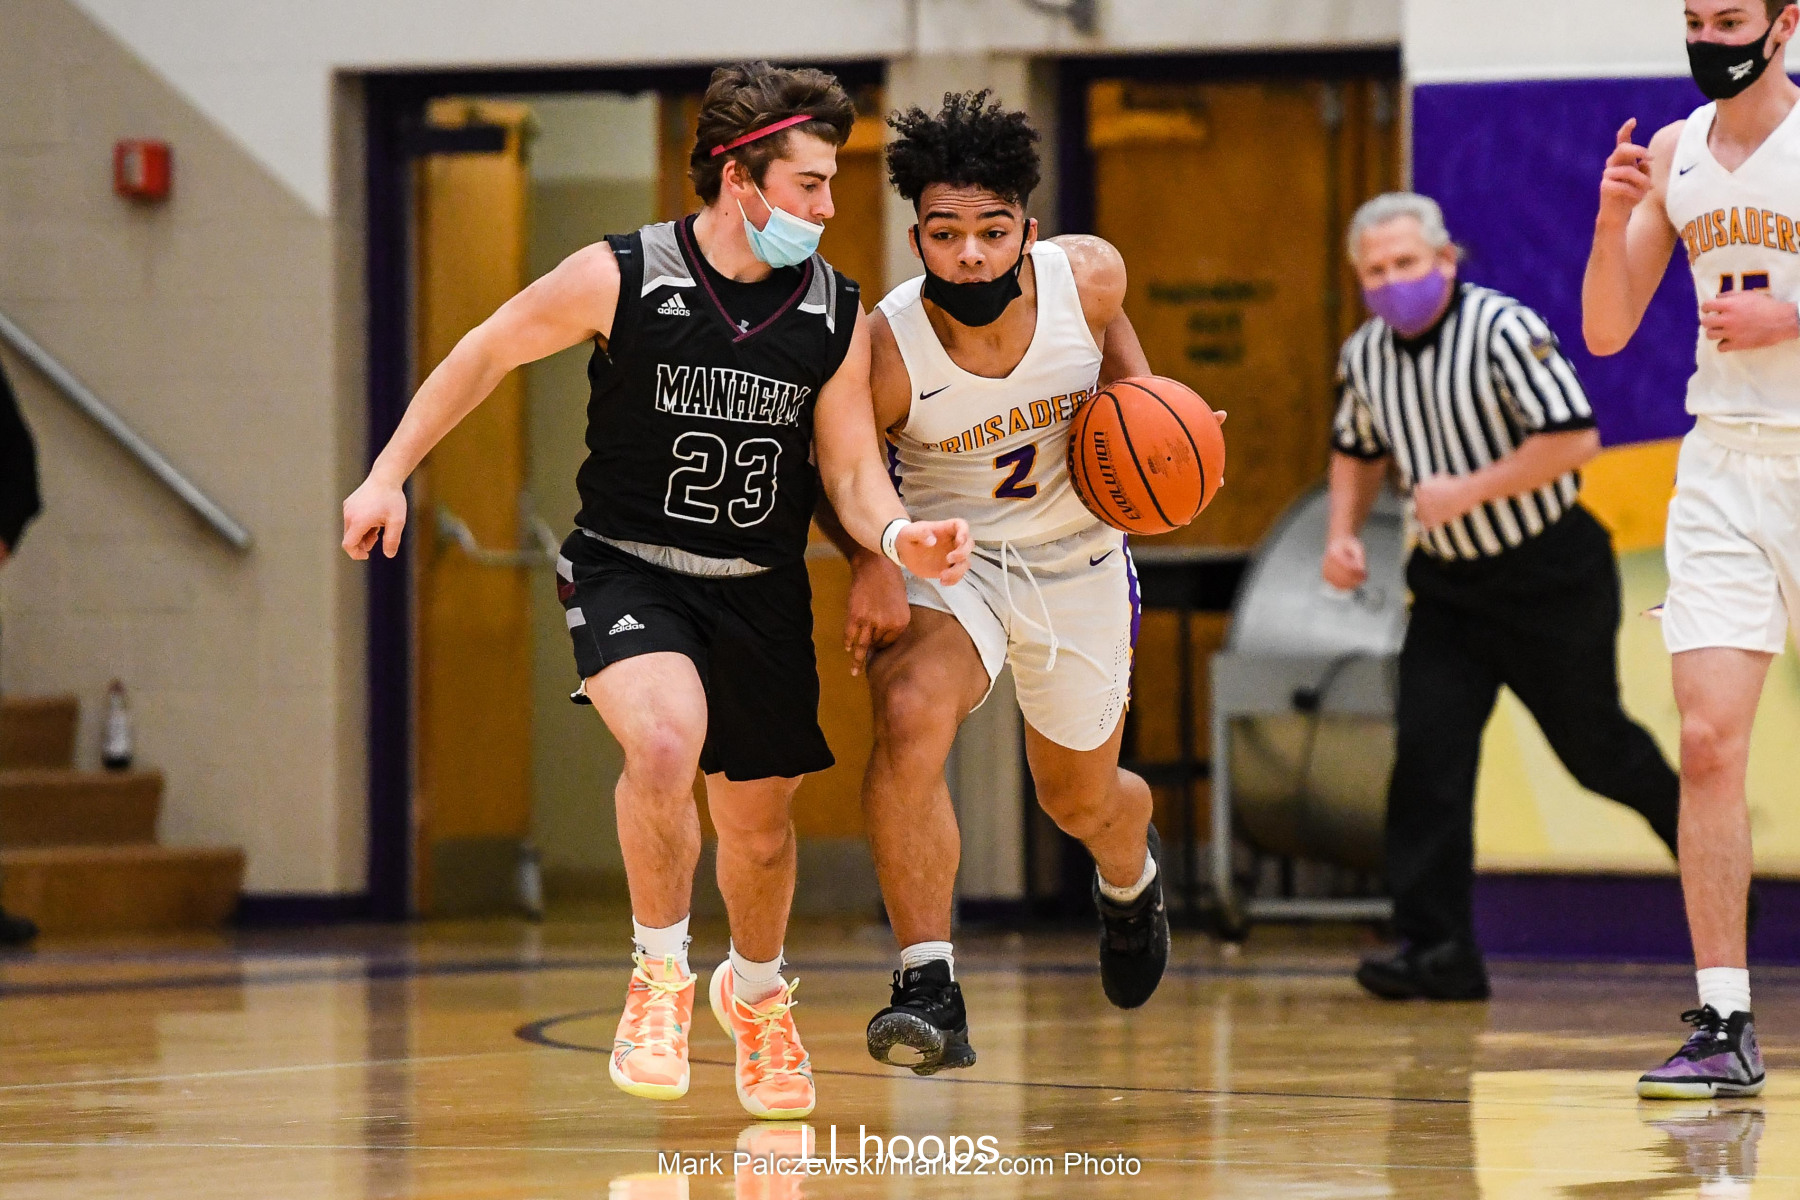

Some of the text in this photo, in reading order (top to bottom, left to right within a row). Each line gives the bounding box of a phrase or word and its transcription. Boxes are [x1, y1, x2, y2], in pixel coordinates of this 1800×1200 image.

[1680, 206, 1800, 266] RUSADER
[657, 306, 691, 317] adidas
[655, 363, 811, 427] MANHEIM
[922, 386, 1095, 453] RUSADER
[664, 431, 782, 528] 23
[992, 441, 1040, 501] 2
[1093, 431, 1142, 520] EVOLUTION
[608, 623, 645, 636] adidas
